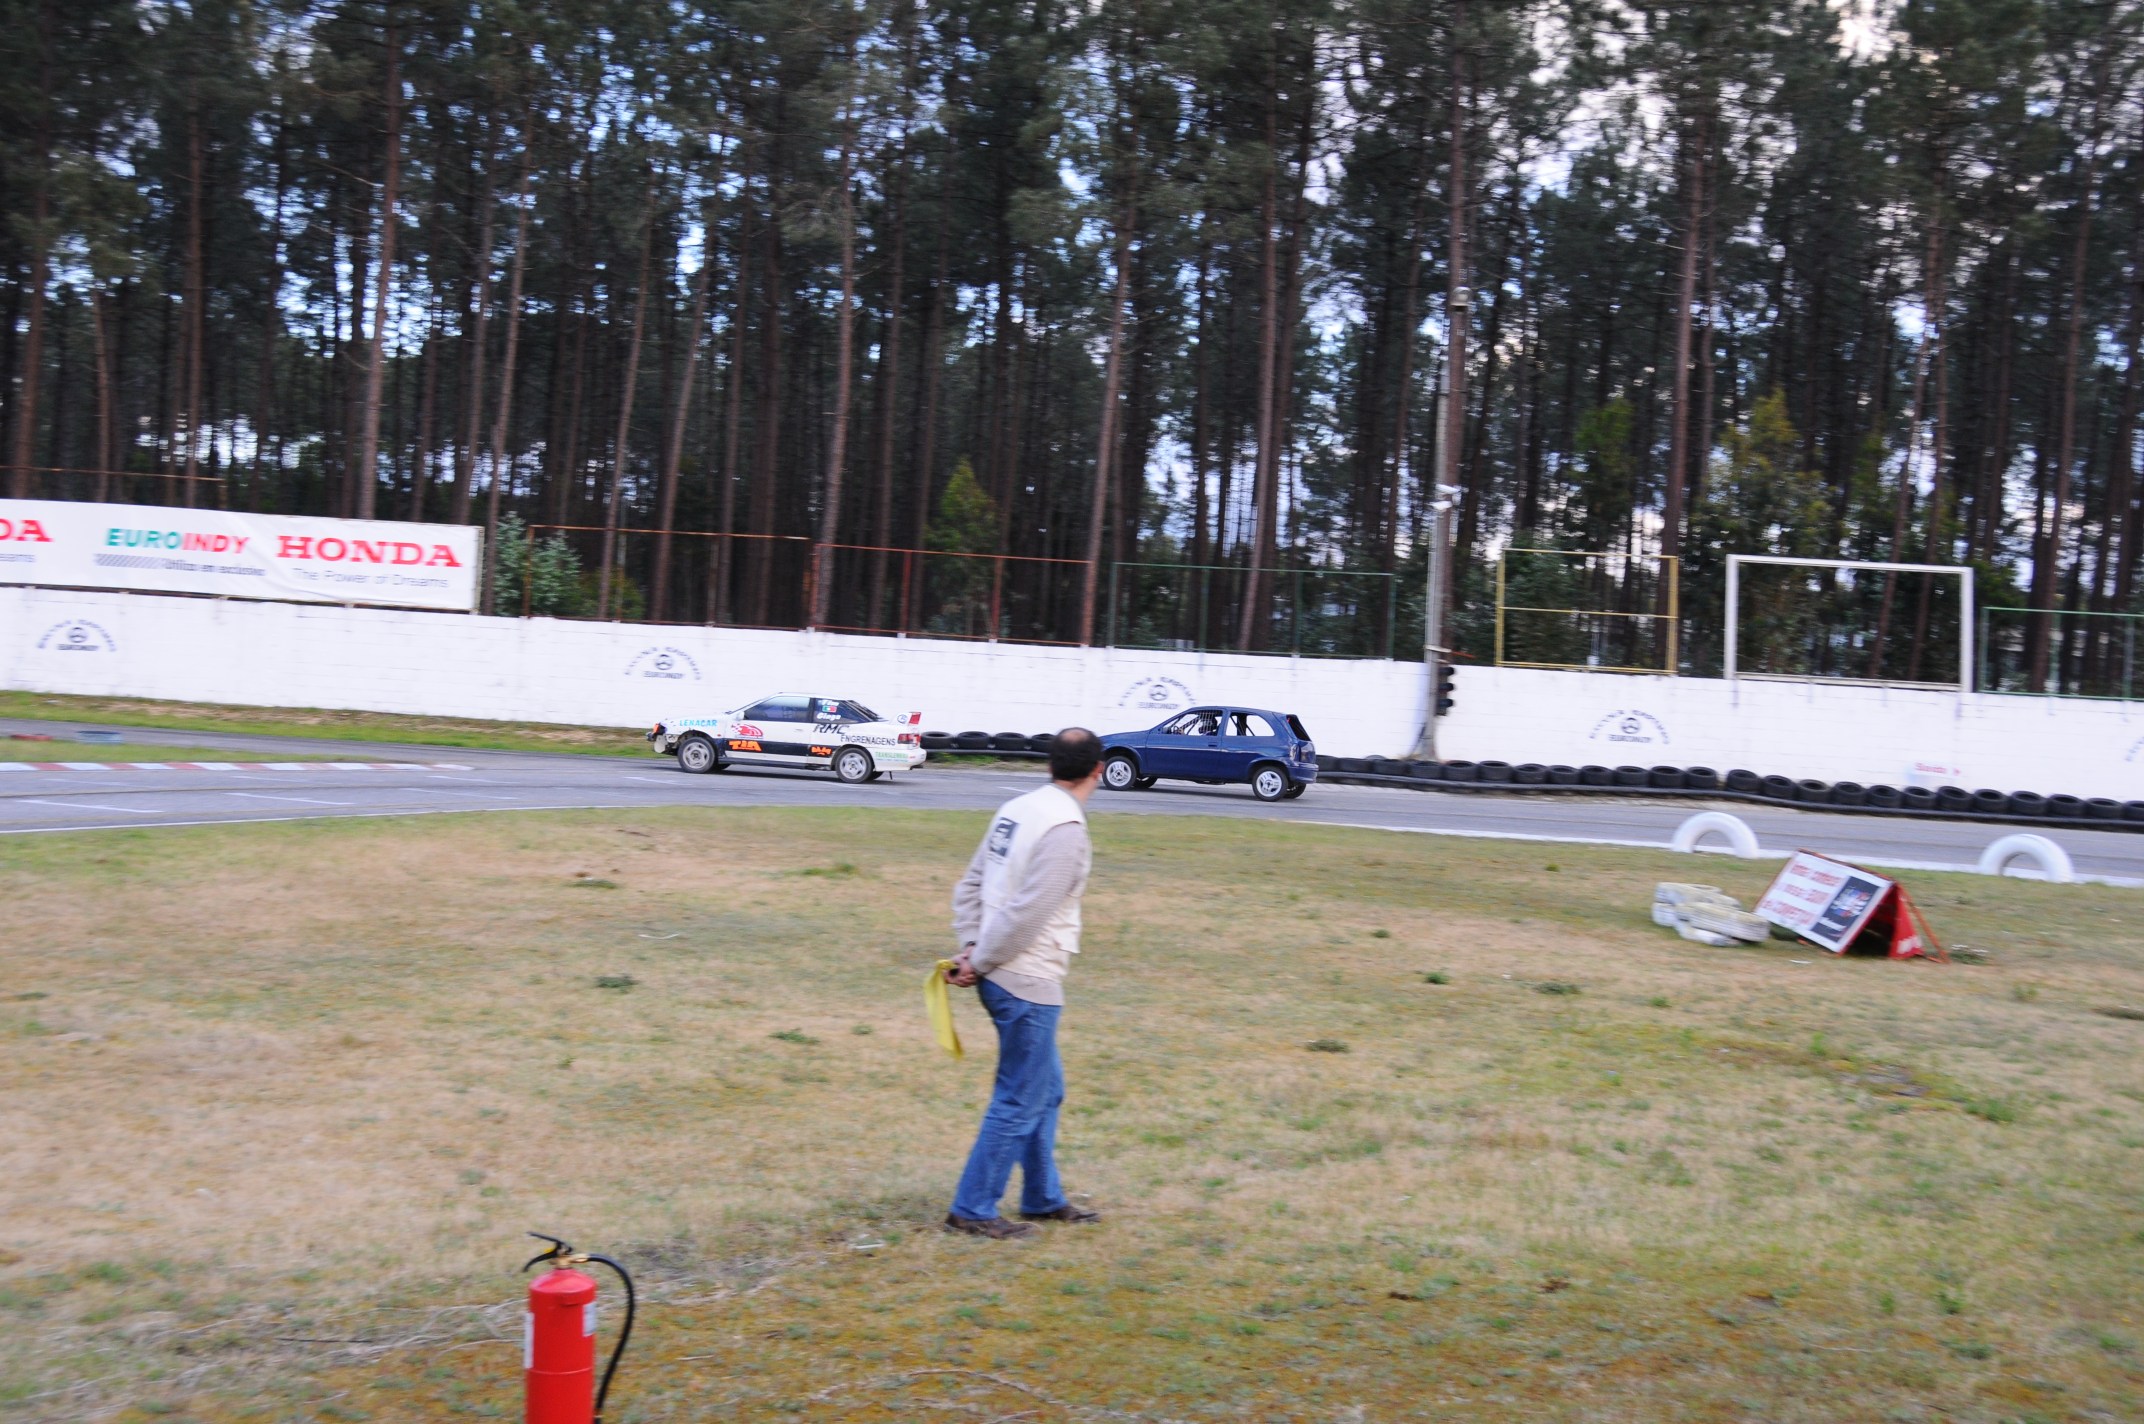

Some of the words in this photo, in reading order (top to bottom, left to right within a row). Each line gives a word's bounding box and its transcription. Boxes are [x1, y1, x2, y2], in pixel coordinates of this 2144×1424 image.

[105, 528, 250, 554] EUROINDY
[277, 535, 464, 568] HONDA
[679, 719, 718, 728] LENACAR
[813, 723, 850, 734] RMC
[840, 734, 896, 746] ENGRENAGENS
